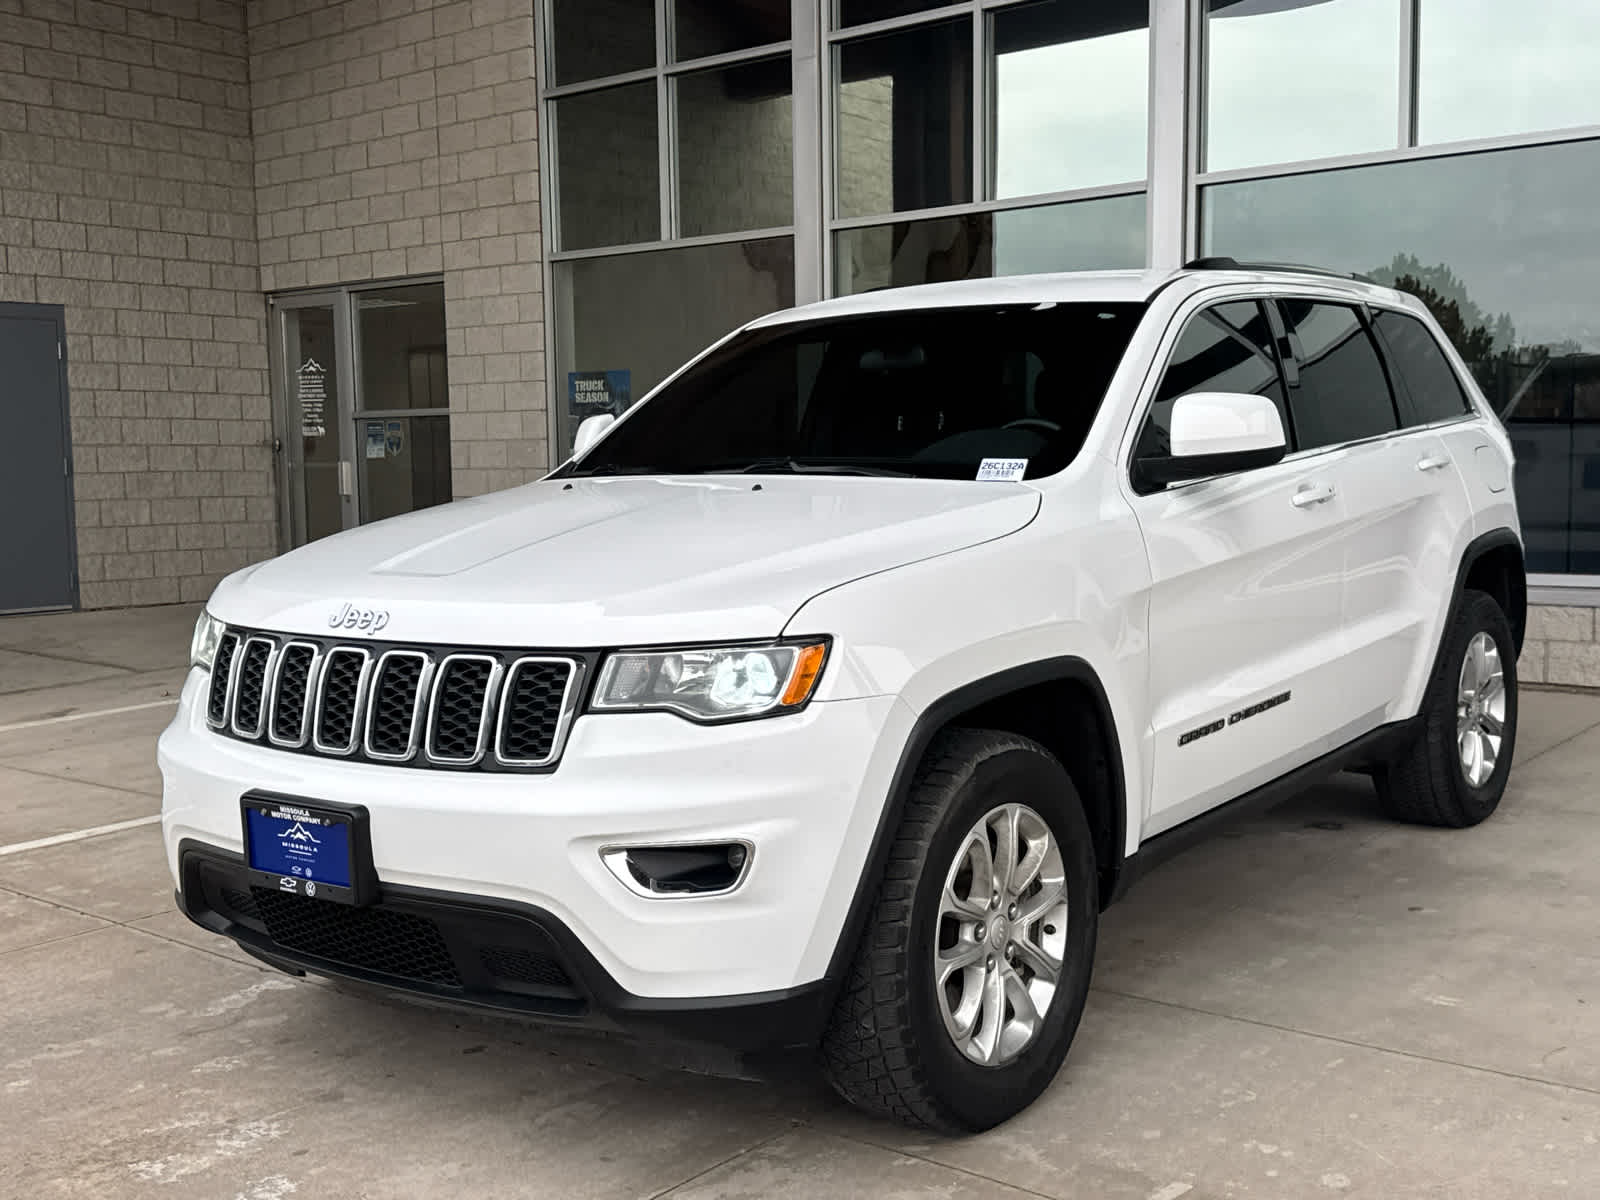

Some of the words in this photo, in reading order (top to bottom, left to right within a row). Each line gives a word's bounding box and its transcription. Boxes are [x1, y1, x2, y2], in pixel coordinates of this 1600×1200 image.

[575, 380, 604, 392] TRUCK
[575, 392, 609, 403] SEASON
[981, 462, 1024, 470] 26C132A
[328, 601, 390, 636] Jeep
[280, 806, 310, 816] MISSOULA
[271, 811, 292, 820] MOTOR
[293, 815, 321, 825] COMPANY
[281, 842, 318, 853] MISSOULA
